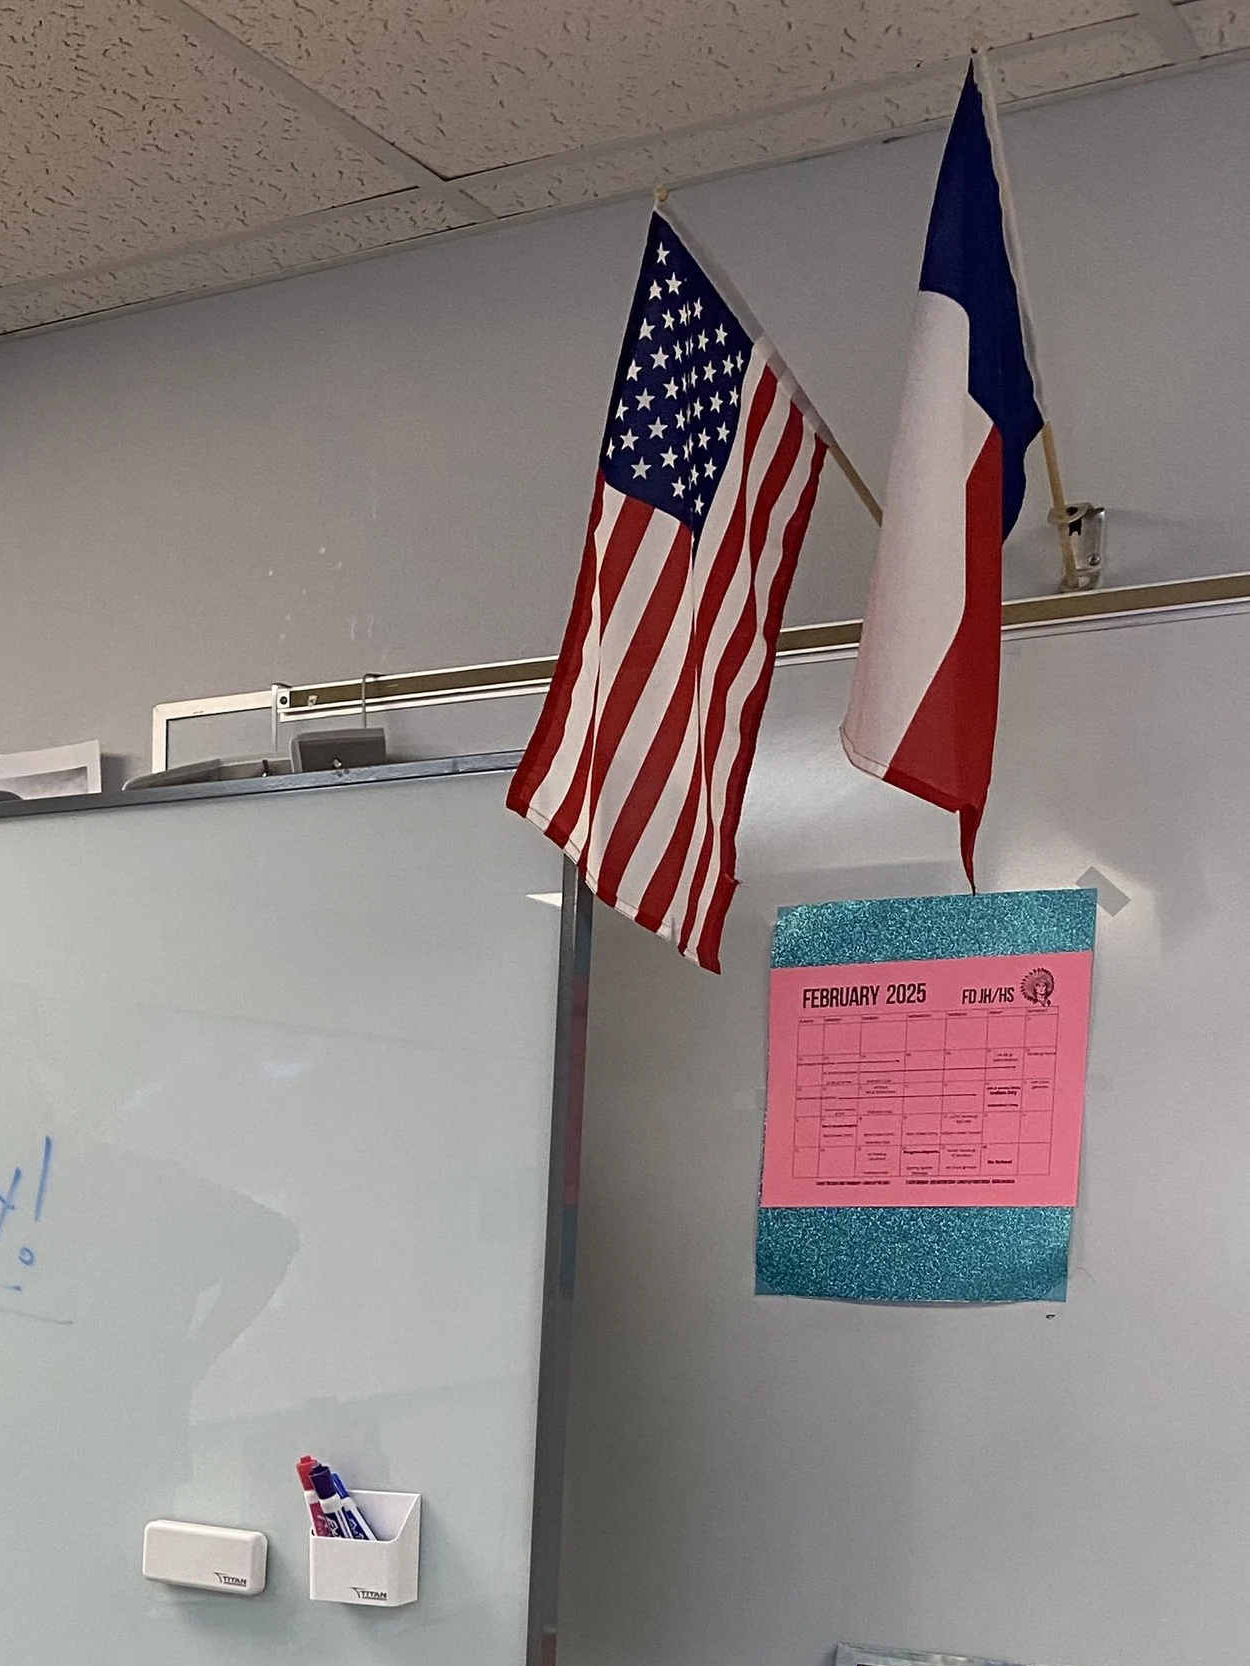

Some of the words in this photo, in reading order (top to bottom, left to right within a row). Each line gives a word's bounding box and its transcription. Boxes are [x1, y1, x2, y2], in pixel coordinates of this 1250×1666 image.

[803, 985, 881, 1009] FEBRUARY
[886, 982, 927, 1005] 2025
[961, 989, 977, 1005] FD
[978, 987, 1015, 1004] JH/HS
